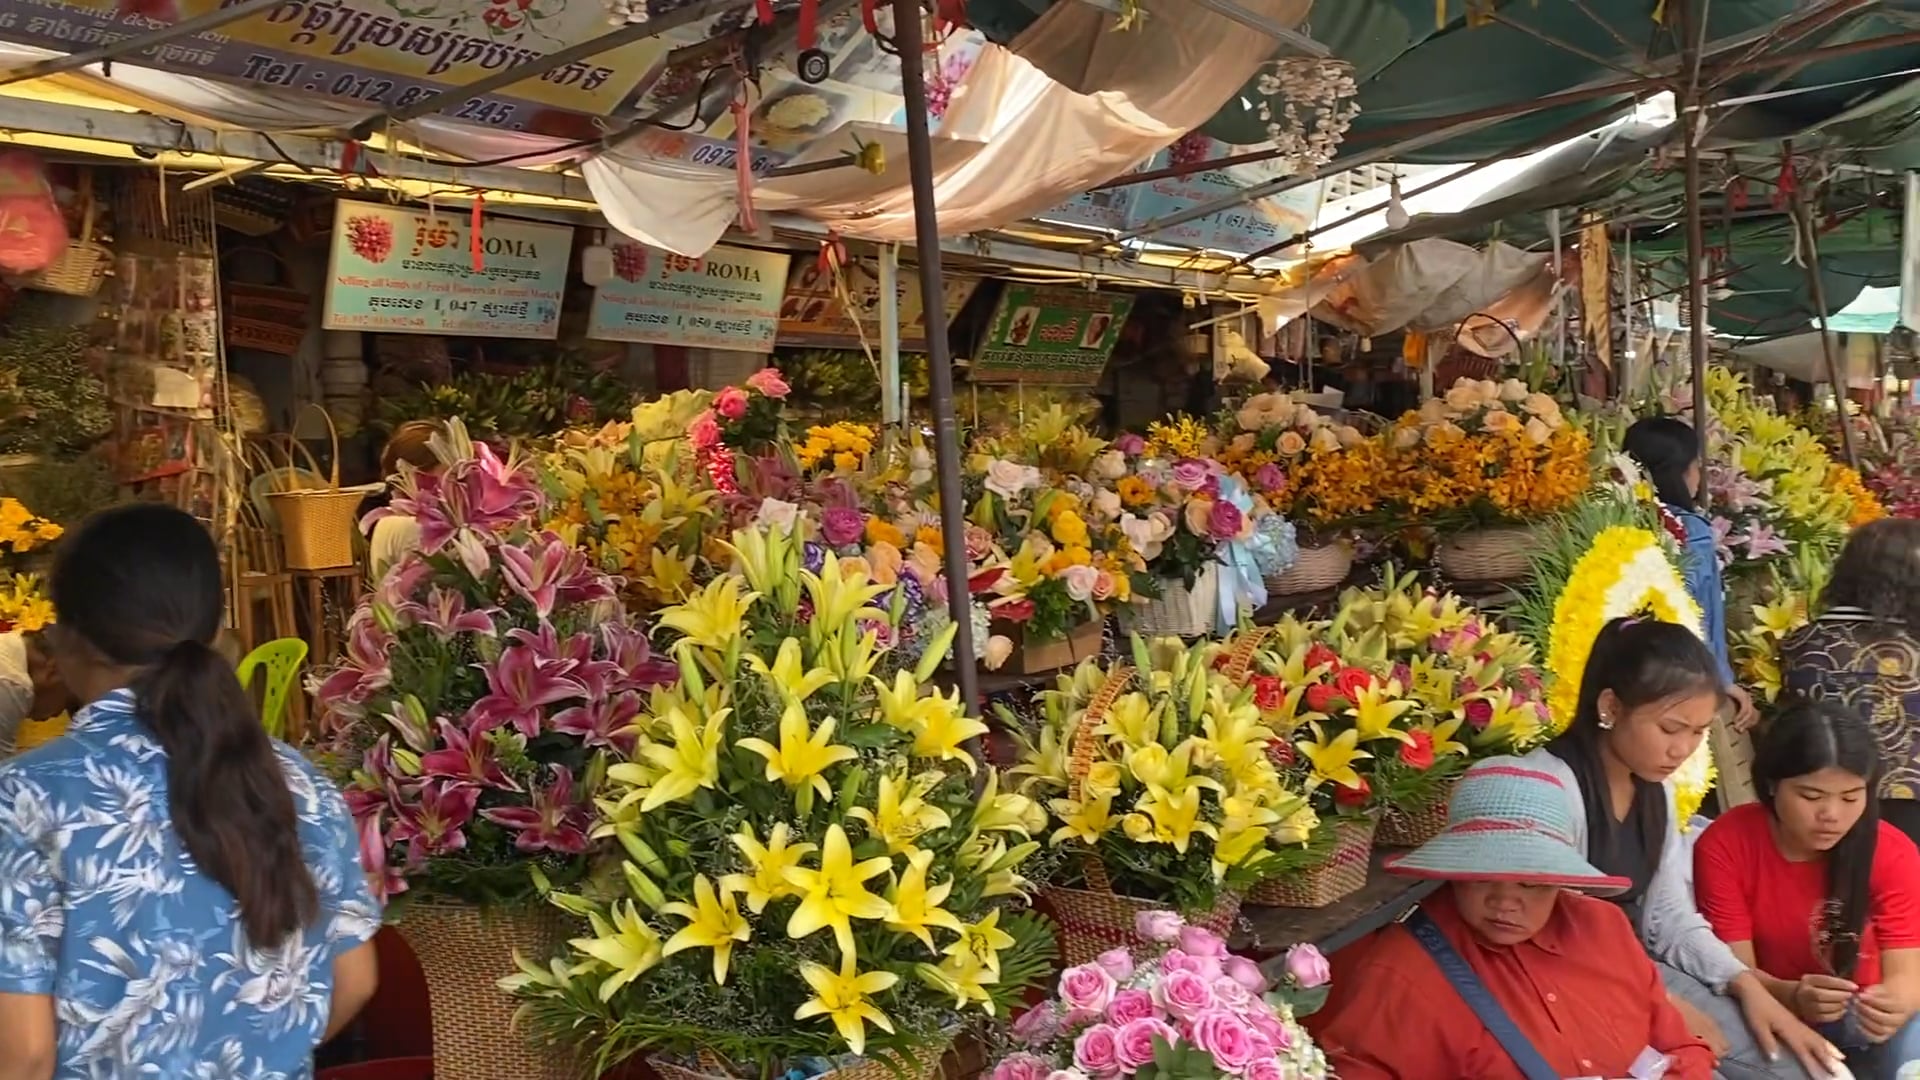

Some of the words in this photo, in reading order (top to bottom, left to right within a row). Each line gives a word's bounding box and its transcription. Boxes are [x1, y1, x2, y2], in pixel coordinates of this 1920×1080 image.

[243, 54, 304, 87] Tel
[331, 74, 393, 102] 012
[706, 261, 761, 283] ROMA
[449, 299, 477, 311] 047
[688, 316, 711, 328] 050
